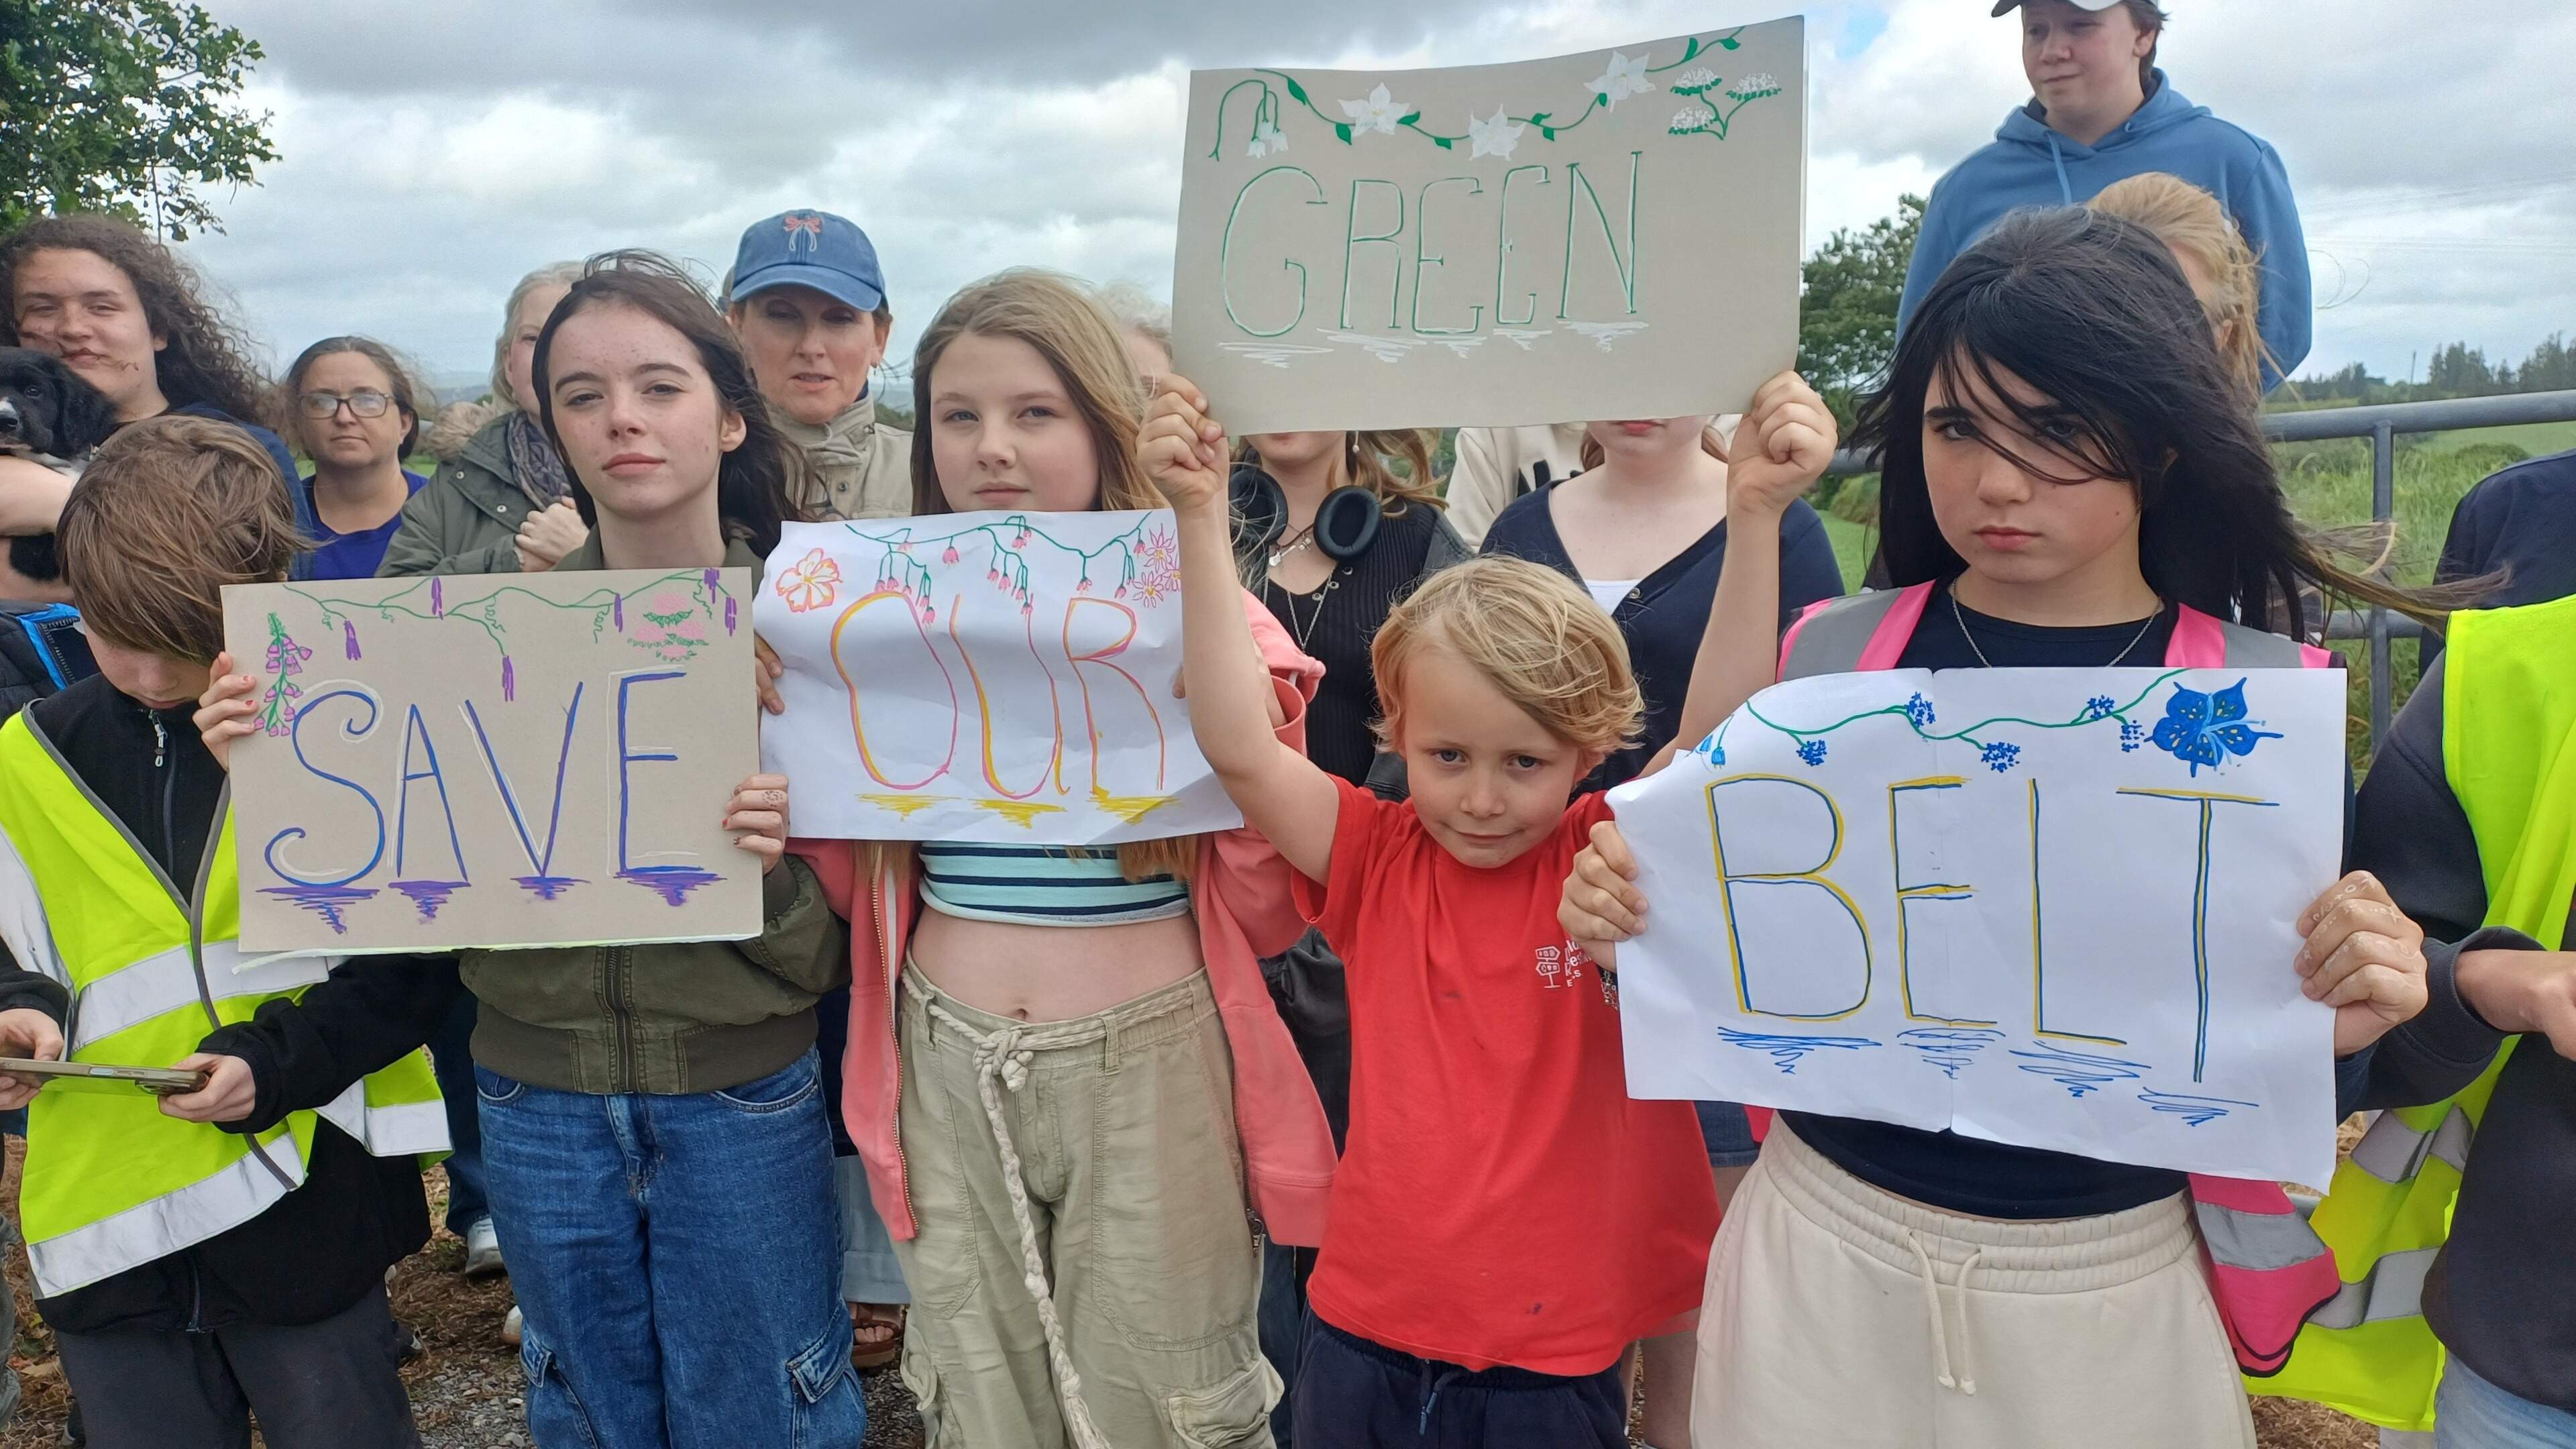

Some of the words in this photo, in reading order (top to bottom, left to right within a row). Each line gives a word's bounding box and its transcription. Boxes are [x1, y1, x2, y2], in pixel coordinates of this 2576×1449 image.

[1222, 151, 1643, 337] GREEN
[264, 664, 704, 888] SAVE
[830, 589, 1165, 800] OUR
[1705, 773, 2280, 1083] BELT
